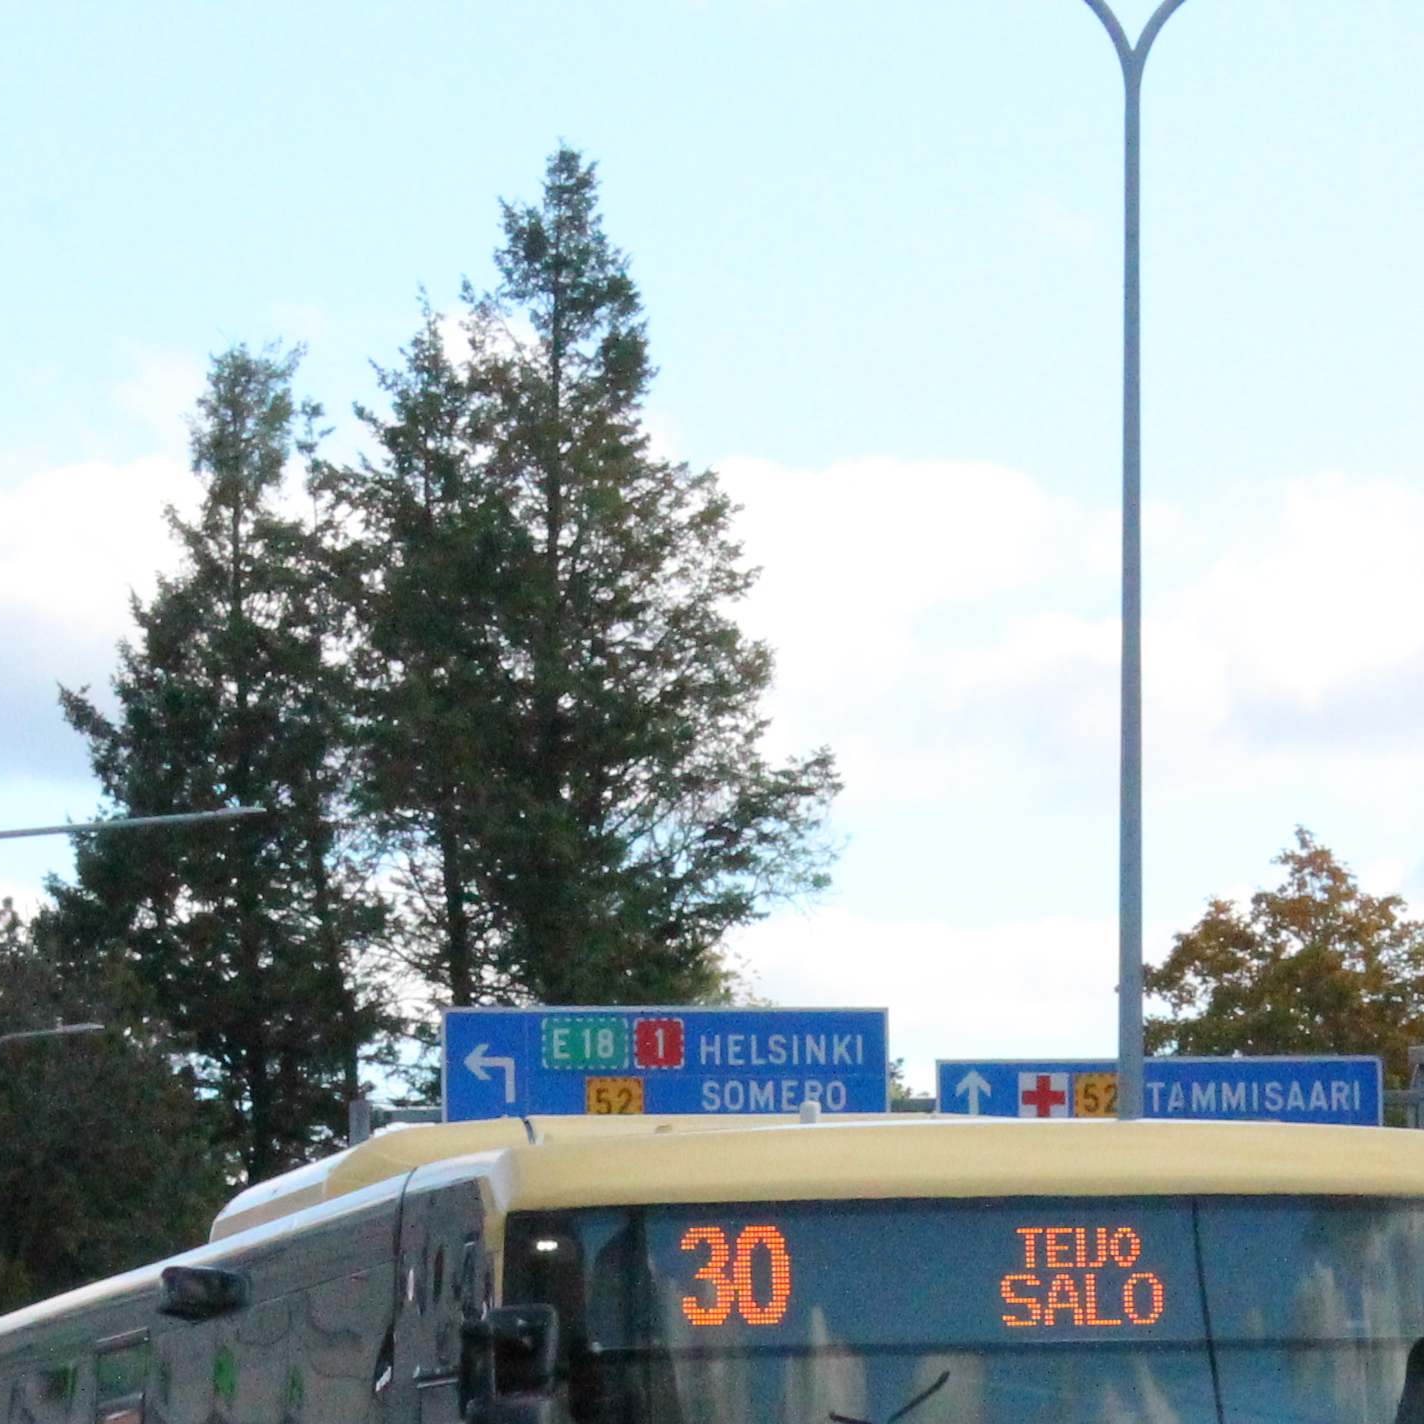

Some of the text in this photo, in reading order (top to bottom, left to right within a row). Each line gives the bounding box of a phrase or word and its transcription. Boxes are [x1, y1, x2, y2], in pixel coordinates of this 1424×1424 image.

[654, 1028, 665, 1059] 1
[699, 1033, 864, 1066] HELSINKI
[596, 1087, 634, 1114] 52
[701, 1080, 847, 1112] SOMERO
[1147, 1080, 1361, 1113] TAMMISAARI
[1015, 1226, 1142, 1268] TEIJO
[681, 1226, 790, 1326] 30
[1000, 1274, 1165, 1327] SALO
